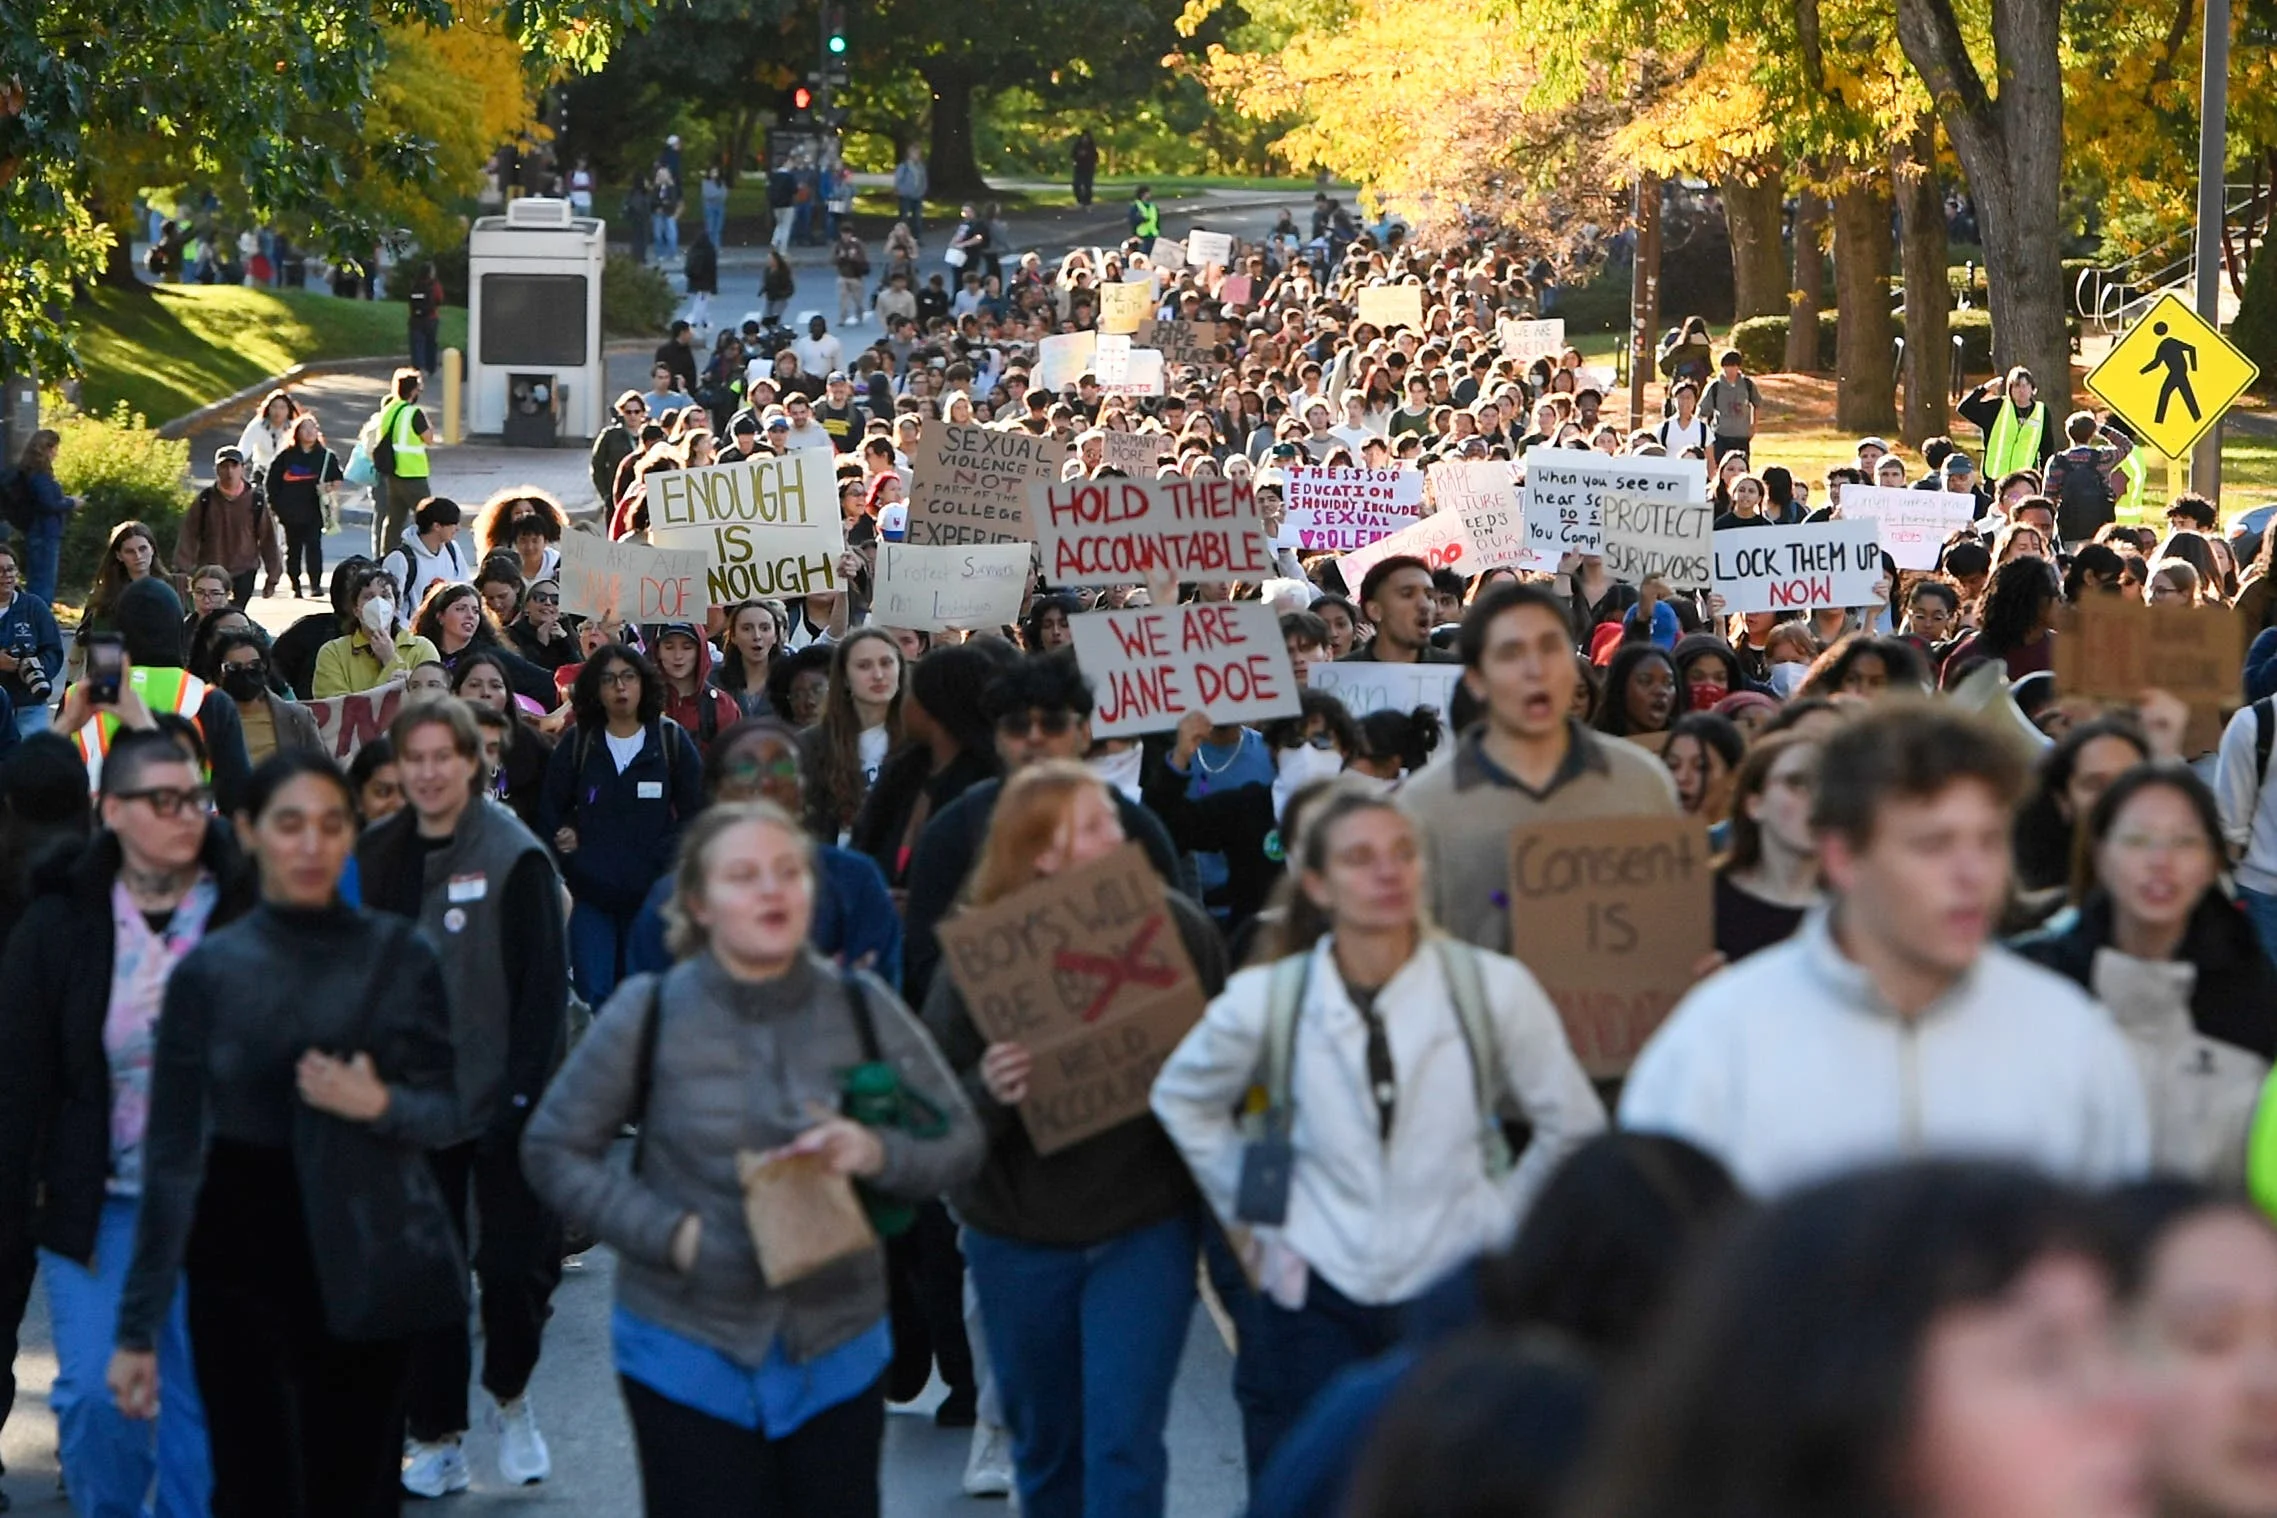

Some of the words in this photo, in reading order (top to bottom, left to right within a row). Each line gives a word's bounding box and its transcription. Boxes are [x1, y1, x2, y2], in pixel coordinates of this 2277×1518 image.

[945, 427, 1052, 464] SEXUAL
[1112, 446, 1145, 462] MORE
[938, 453, 1028, 475] VIOLENCE
[1035, 467, 1051, 478] IS
[954, 470, 1022, 492] NOT
[1289, 467, 1337, 480] THE
[1435, 465, 1476, 494] RAPE
[1538, 470, 1577, 485] When
[1582, 475, 1608, 488] you
[1616, 477, 1649, 492] see
[1656, 479, 1679, 492] or
[661, 459, 807, 524] ENOUGH
[934, 483, 972, 495] PART
[1048, 484, 1149, 528] HOLD
[1161, 481, 1257, 520] THEM
[1290, 482, 1394, 500] EDUCATION
[1534, 488, 1576, 506] hear
[929, 500, 1022, 522] COLLEGE
[1312, 510, 1390, 527] SEXUAL
[1363, 501, 1420, 516] INCLUDE
[1464, 512, 1508, 528] EEDS
[1560, 507, 1578, 520] DO
[1603, 495, 1712, 539] PROTECT
[715, 525, 753, 563] IS
[1473, 527, 1494, 538] ON
[1476, 534, 1518, 550] OUR
[1530, 522, 1553, 540] You
[887, 546, 950, 583] Protect
[1056, 530, 1266, 579] ACCOUNTABLE
[1605, 541, 1710, 583] SURVIVORS
[1715, 547, 1782, 581] LOCK
[1785, 542, 1845, 573] THEM
[1856, 542, 1880, 571] UP
[707, 552, 834, 604] NOUGH
[1770, 575, 1831, 606] NOW
[640, 576, 692, 619] DOE
[1108, 615, 1172, 660] WE
[1182, 605, 1248, 652] ARE
[1099, 665, 1186, 724] JANE
[1195, 655, 1279, 705] DOE
[1516, 833, 1695, 899] Consent
[953, 904, 1070, 982] BOYS
[1586, 901, 1640, 955] IS
[983, 980, 1049, 1041] BE
